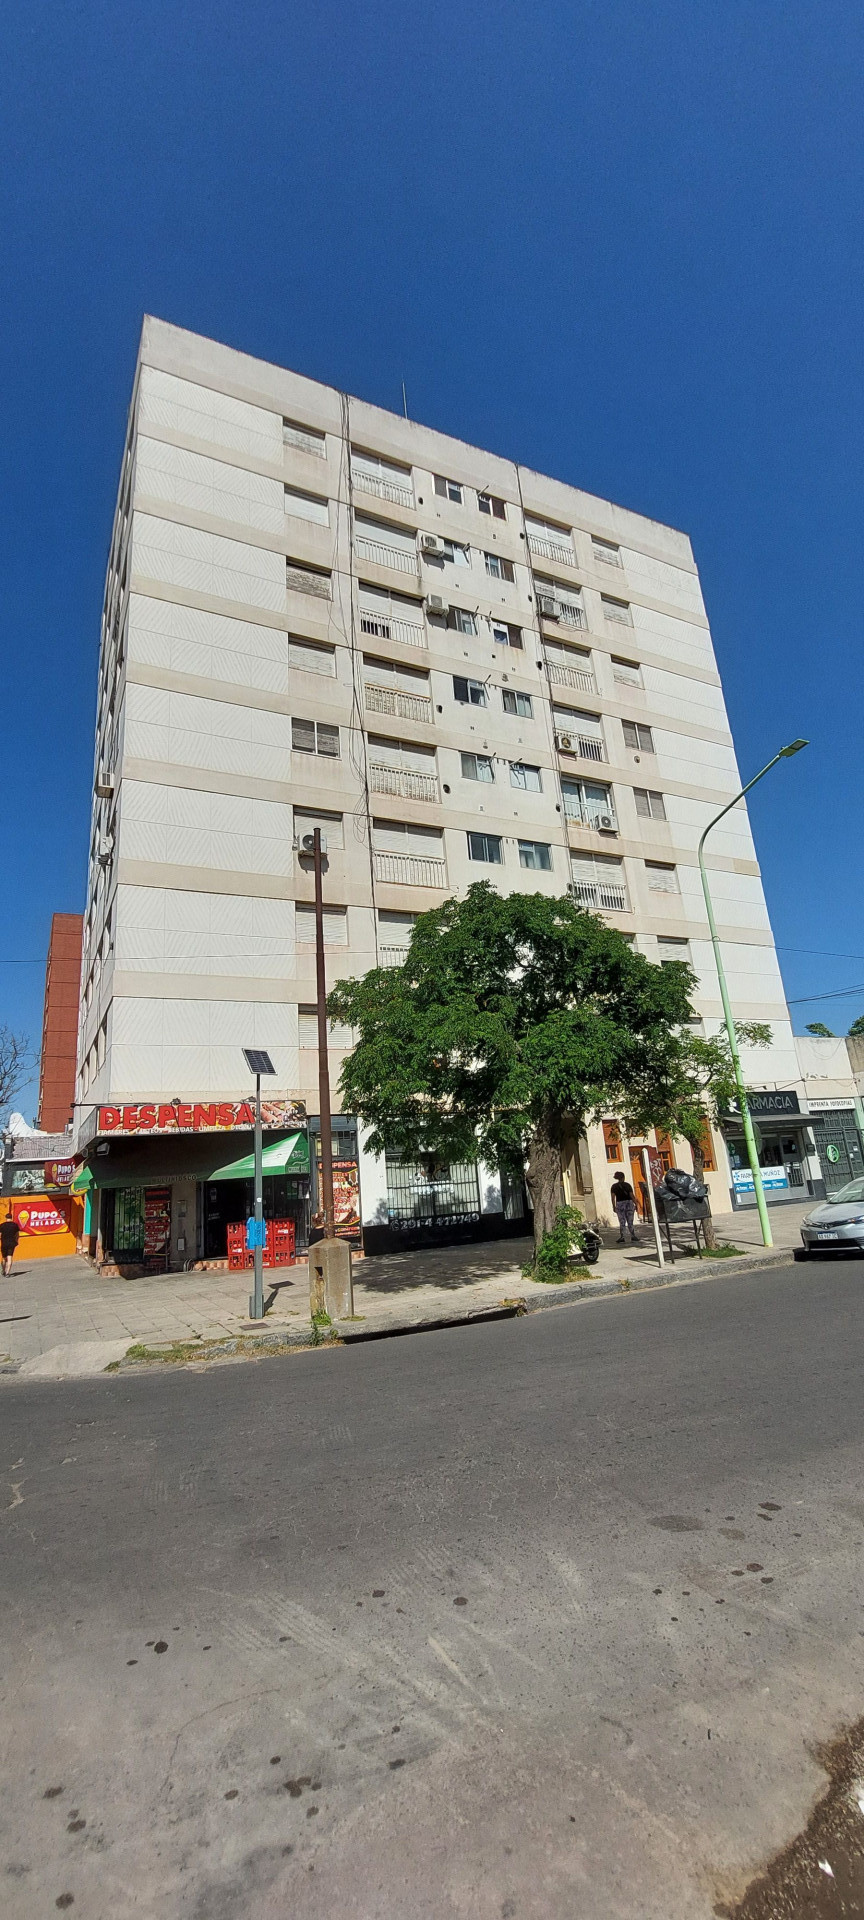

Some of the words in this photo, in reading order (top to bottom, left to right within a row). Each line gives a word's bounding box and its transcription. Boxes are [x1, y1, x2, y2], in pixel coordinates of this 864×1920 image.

[746, 1095, 793, 1110] ARMACIA
[98, 1102, 255, 1131] DESPENSA
[318, 1160, 358, 1169] DPENSA
